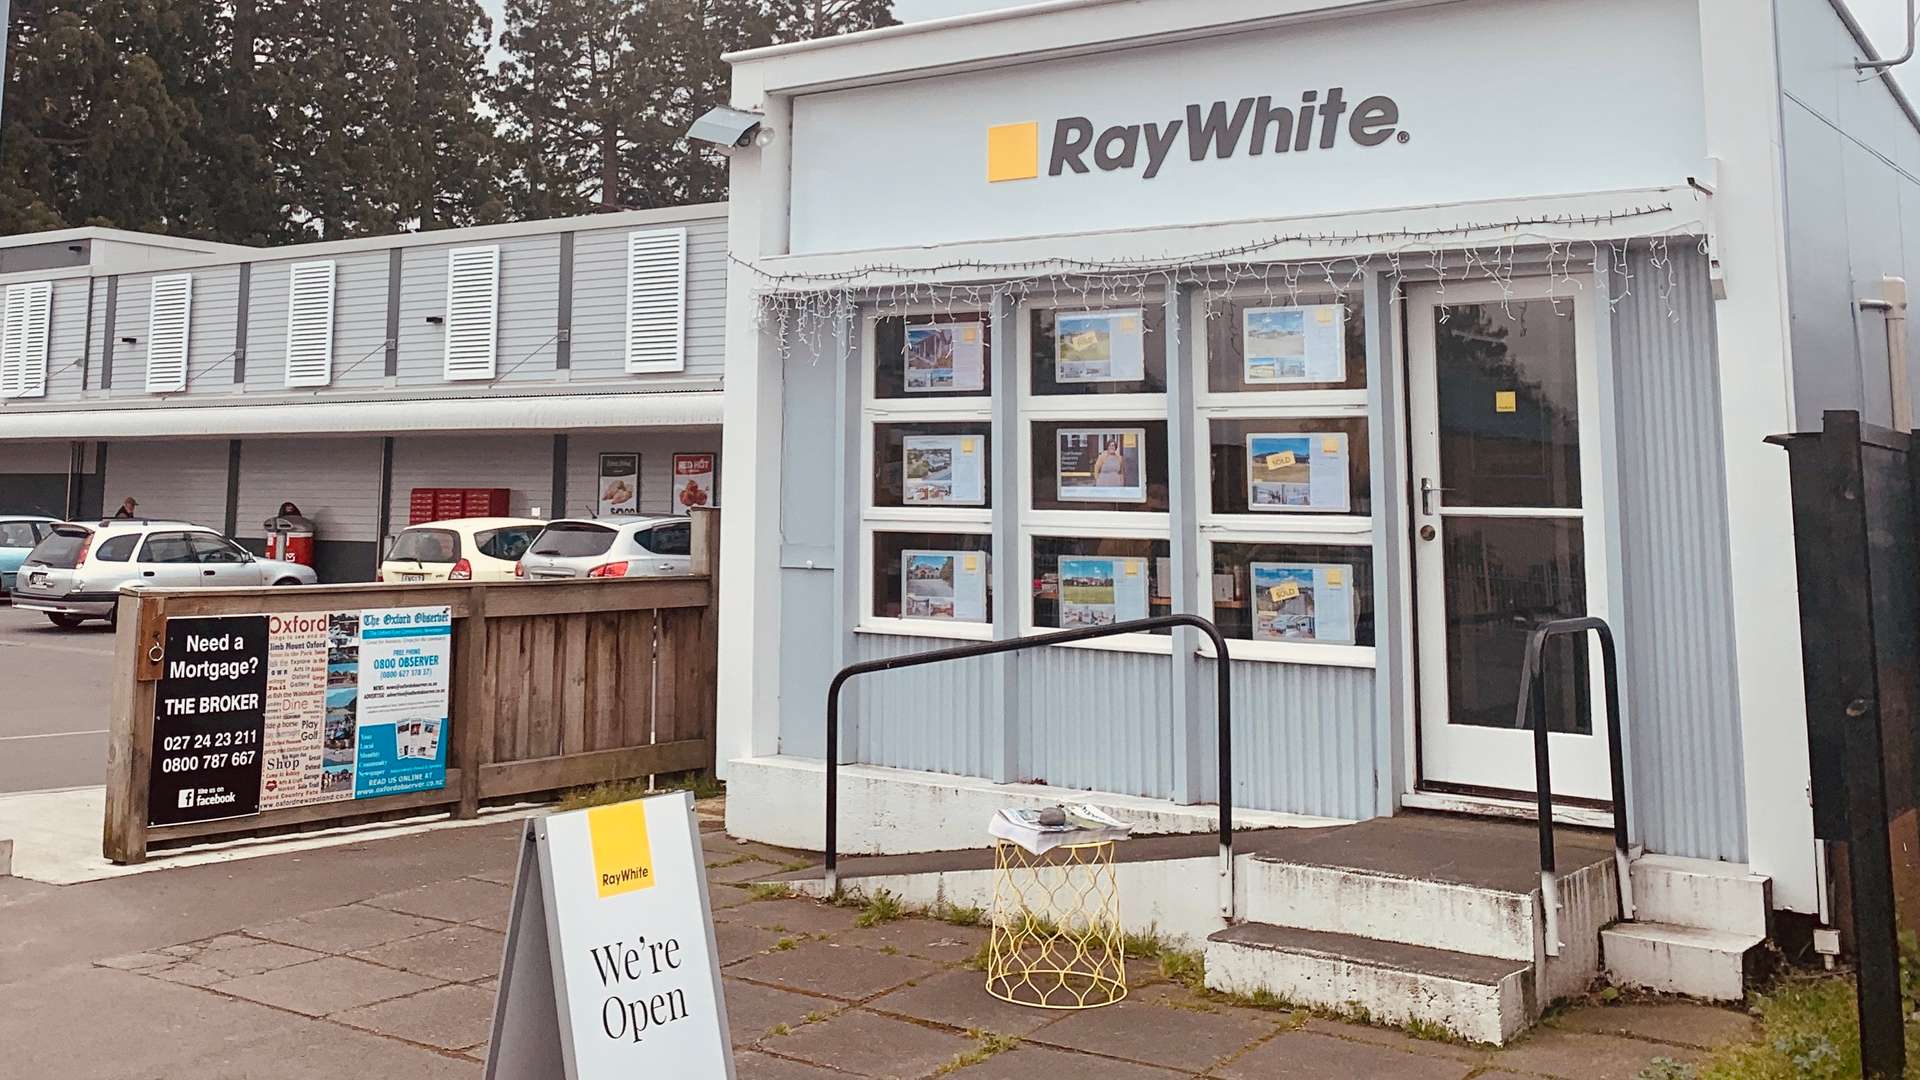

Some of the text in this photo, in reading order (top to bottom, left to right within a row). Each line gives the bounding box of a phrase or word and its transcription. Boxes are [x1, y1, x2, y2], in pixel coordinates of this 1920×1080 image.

[1048, 87, 1399, 179] RayWhite
[1271, 457, 1292, 466] SOLD
[1275, 588, 1296, 598] SOLD
[363, 612, 449, 627] The Oxford Observer
[186, 633, 244, 652] Need a
[285, 641, 305, 650] Mount
[306, 640, 326, 649] Oxford
[169, 656, 259, 681] Mortgage?
[373, 655, 439, 669] 0800 OBSERVER
[164, 693, 259, 715] THE BROKER
[282, 698, 309, 711] Dine
[301, 719, 318, 731] Play
[163, 735, 191, 751] 027
[194, 734, 211, 749] 24
[214, 732, 232, 747] 23
[234, 729, 257, 745] 211
[301, 731, 318, 742] Golf
[162, 755, 199, 773] 0800
[202, 753, 228, 769] 787
[231, 750, 256, 766] 667
[267, 757, 300, 771] Shop
[368, 771, 433, 786] READ US ONLINE AT
[196, 791, 236, 806] facebook
[602, 866, 649, 887] RayWhite
[590, 935, 683, 988] We’re
[601, 988, 689, 1043] Open
